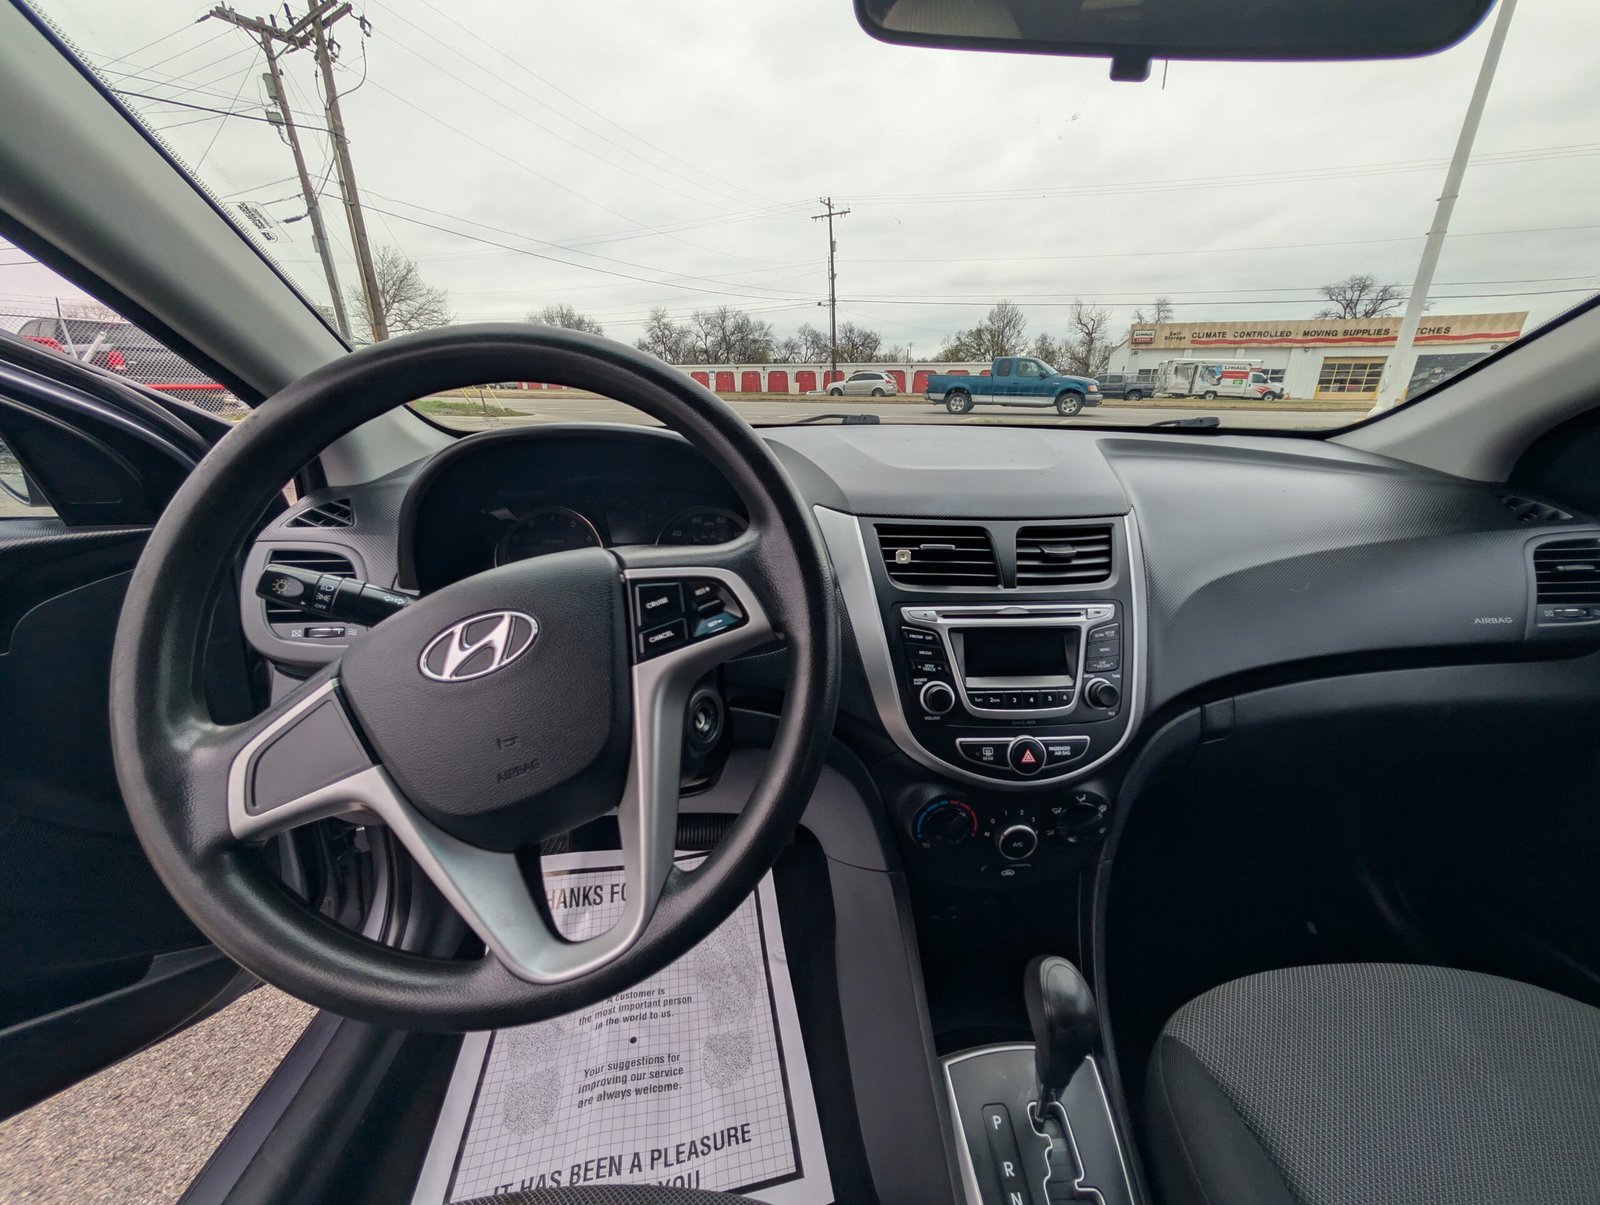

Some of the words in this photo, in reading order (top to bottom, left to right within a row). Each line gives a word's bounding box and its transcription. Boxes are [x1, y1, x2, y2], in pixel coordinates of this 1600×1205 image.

[1191, 331, 1227, 339] CLIMATE
[1233, 330, 1292, 338] CONTROLLED
[1342, 328, 1390, 337] SUPPLIES
[1474, 616, 1512, 624] AIRBAG
[648, 630, 675, 643] CANCEL
[546, 884, 604, 910] HANKS
[615, 989, 655, 1001] customer
[658, 988, 665, 996] is
[579, 1015, 592, 1026] the
[595, 1006, 616, 1020] most
[618, 1000, 660, 1012] important
[663, 996, 692, 1007] person
[595, 1022, 603, 1030] in
[606, 1017, 619, 1026] the
[622, 1012, 647, 1023] world
[650, 1012, 658, 1020] to
[661, 1010, 674, 1018] us.
[584, 1065, 605, 1078] Your
[607, 1056, 665, 1071] suggestions
[668, 1053, 680, 1062] for
[578, 1074, 627, 1094] improving
[630, 1072, 646, 1082] our
[649, 1067, 684, 1079] service
[578, 1096, 594, 1108] are
[596, 1088, 632, 1102] always
[635, 1082, 682, 1096] welcome.
[992, 1115, 1002, 1130] P
[520, 1170, 562, 1192] HAS
[568, 1154, 623, 1186] BEEN
[629, 1152, 643, 1174] A
[650, 1123, 752, 1170] PLEASURE
[1004, 1161, 1015, 1178] R
[1011, 1192, 1024, 1205] N
